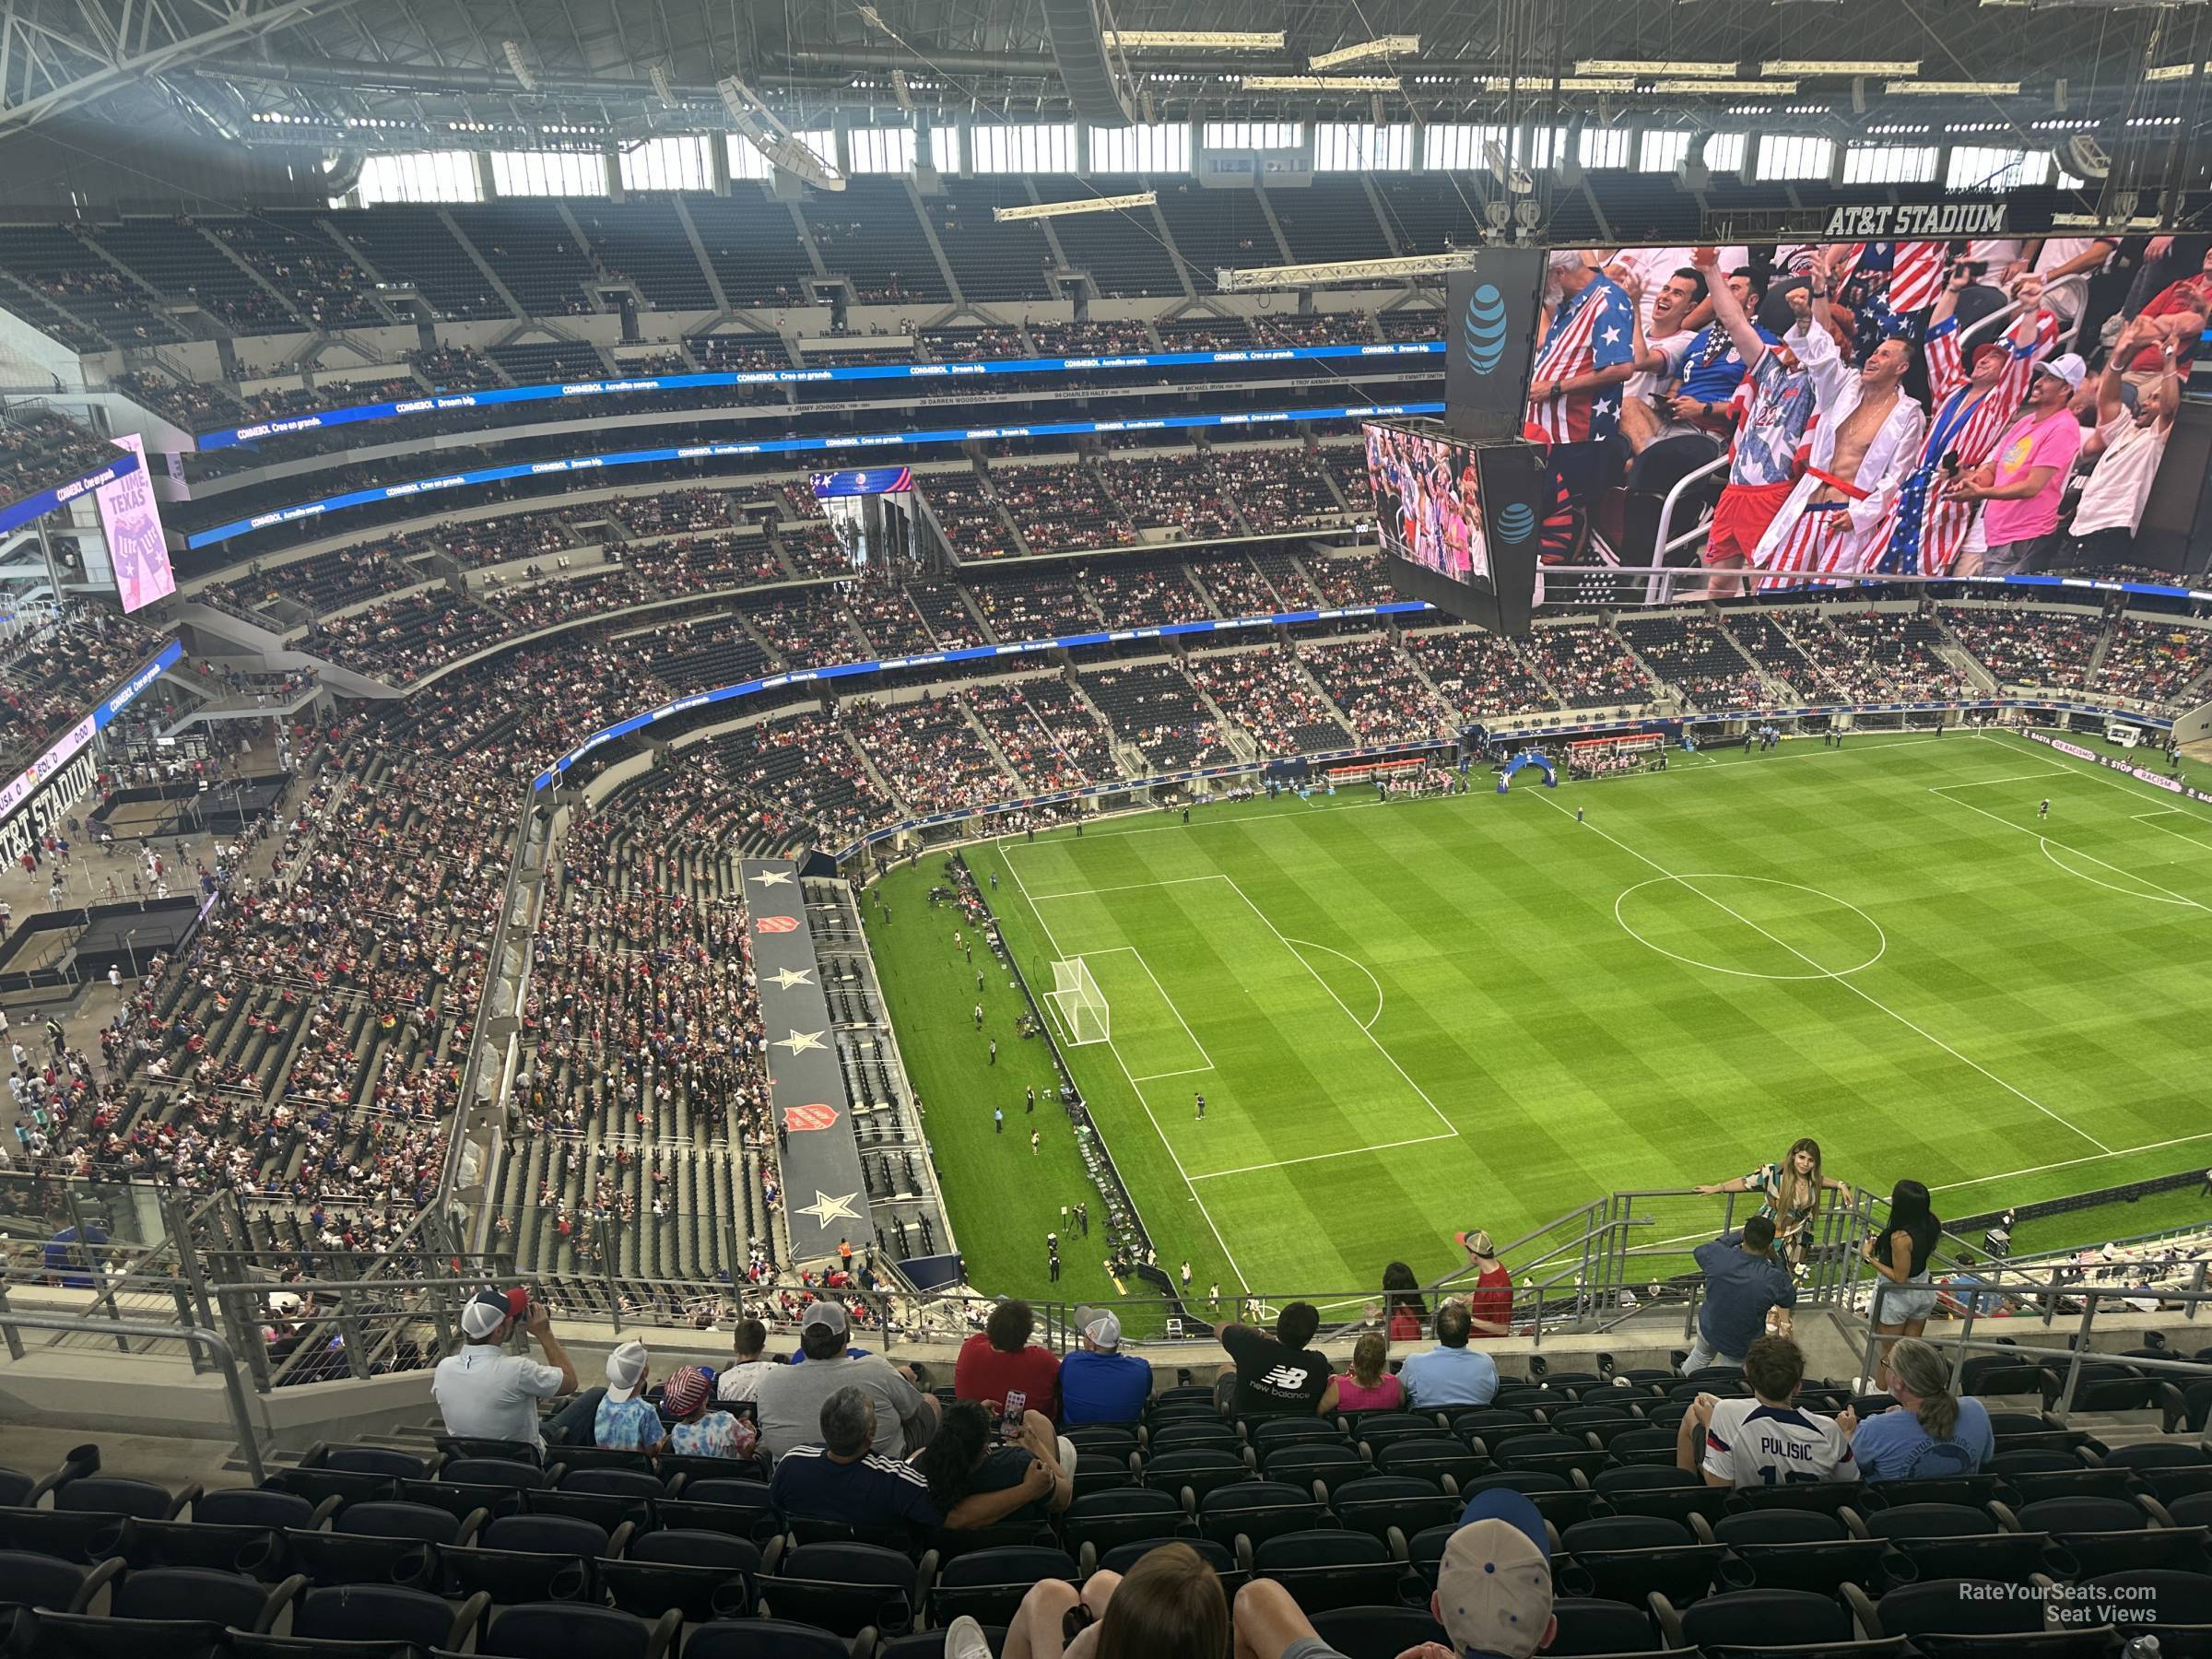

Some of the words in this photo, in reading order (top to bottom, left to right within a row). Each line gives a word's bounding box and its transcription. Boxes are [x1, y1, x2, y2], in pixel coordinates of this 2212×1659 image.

[1825, 207, 1893, 235] AT&T
[1894, 204, 2007, 233] STADIUM
[737, 372, 778, 382] CONMEBOL
[911, 366, 947, 374] CONMEBOL
[563, 384, 603, 394] CONMEBOL
[396, 400, 434, 413] CONMEBOL
[438, 398, 463, 408] Dream
[928, 397, 954, 406] DARREN
[238, 425, 272, 440] CONMEBOL
[272, 423, 288, 433] Cree
[288, 421, 298, 429] en
[109, 488, 146, 515] TEXAS
[118, 535, 137, 559] Lite
[139, 525, 158, 555] Lite
[75, 724, 88, 744] 0:00
[2031, 732, 2051, 745] BASTA
[2054, 740, 2065, 749] DE
[2065, 744, 2093, 759] RACISMO
[2111, 759, 2133, 774] STOP
[2141, 771, 2172, 788] RACISM
[31, 747, 100, 837] STADIUM
[1250, 1380, 1270, 1393] new
[1272, 1386, 1311, 1399] balance
[1761, 1437, 1813, 1461] PULISIC
